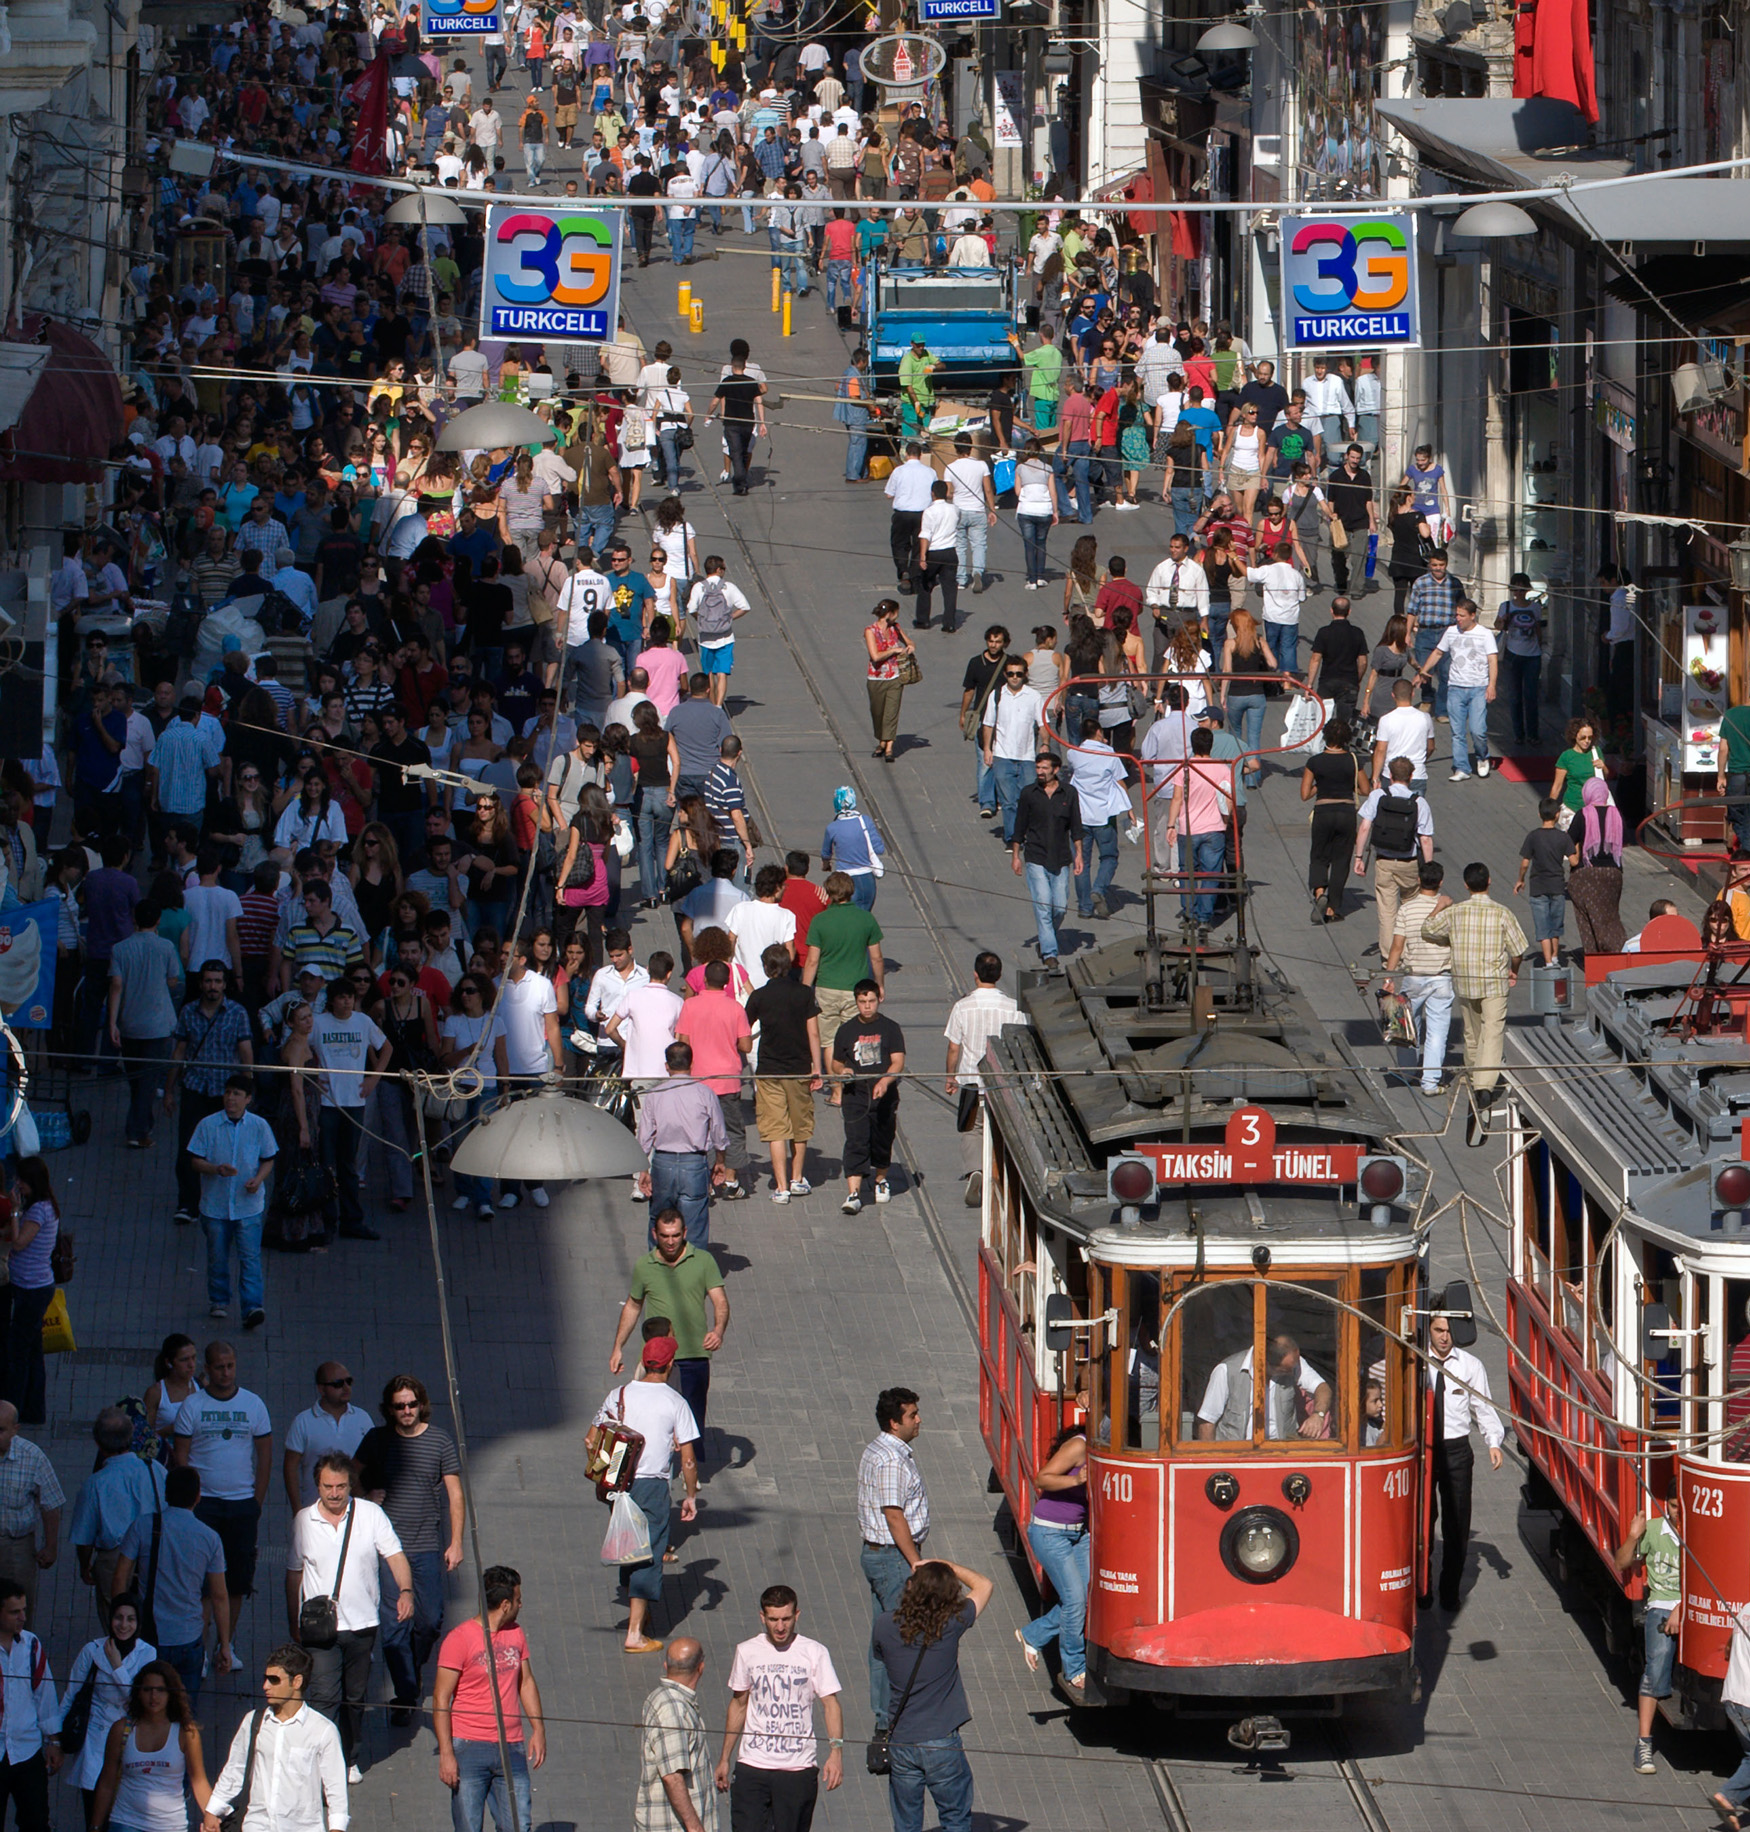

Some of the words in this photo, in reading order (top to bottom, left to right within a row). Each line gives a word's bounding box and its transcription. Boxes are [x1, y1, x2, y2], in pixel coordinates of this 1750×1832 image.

[928, 0, 993, 15] TURKCELL
[430, 17, 496, 30] TURKCELL
[494, 214, 613, 307] 3G
[1291, 222, 1408, 314] 3G
[496, 310, 602, 332] TURKCELL
[1298, 316, 1406, 338] TURKCELL
[583, 588, 597, 613] 9
[1240, 1115, 1261, 1146] 3
[1161, 1150, 1233, 1179] TAKSİM
[1272, 1150, 1339, 1179] TÜNEL
[1102, 1471, 1133, 1503] 410
[1383, 1467, 1410, 1499] 410
[1692, 1485, 1723, 1518] 223
[750, 1674, 809, 1702] YACHT
[758, 1703, 810, 1719] MONEY
